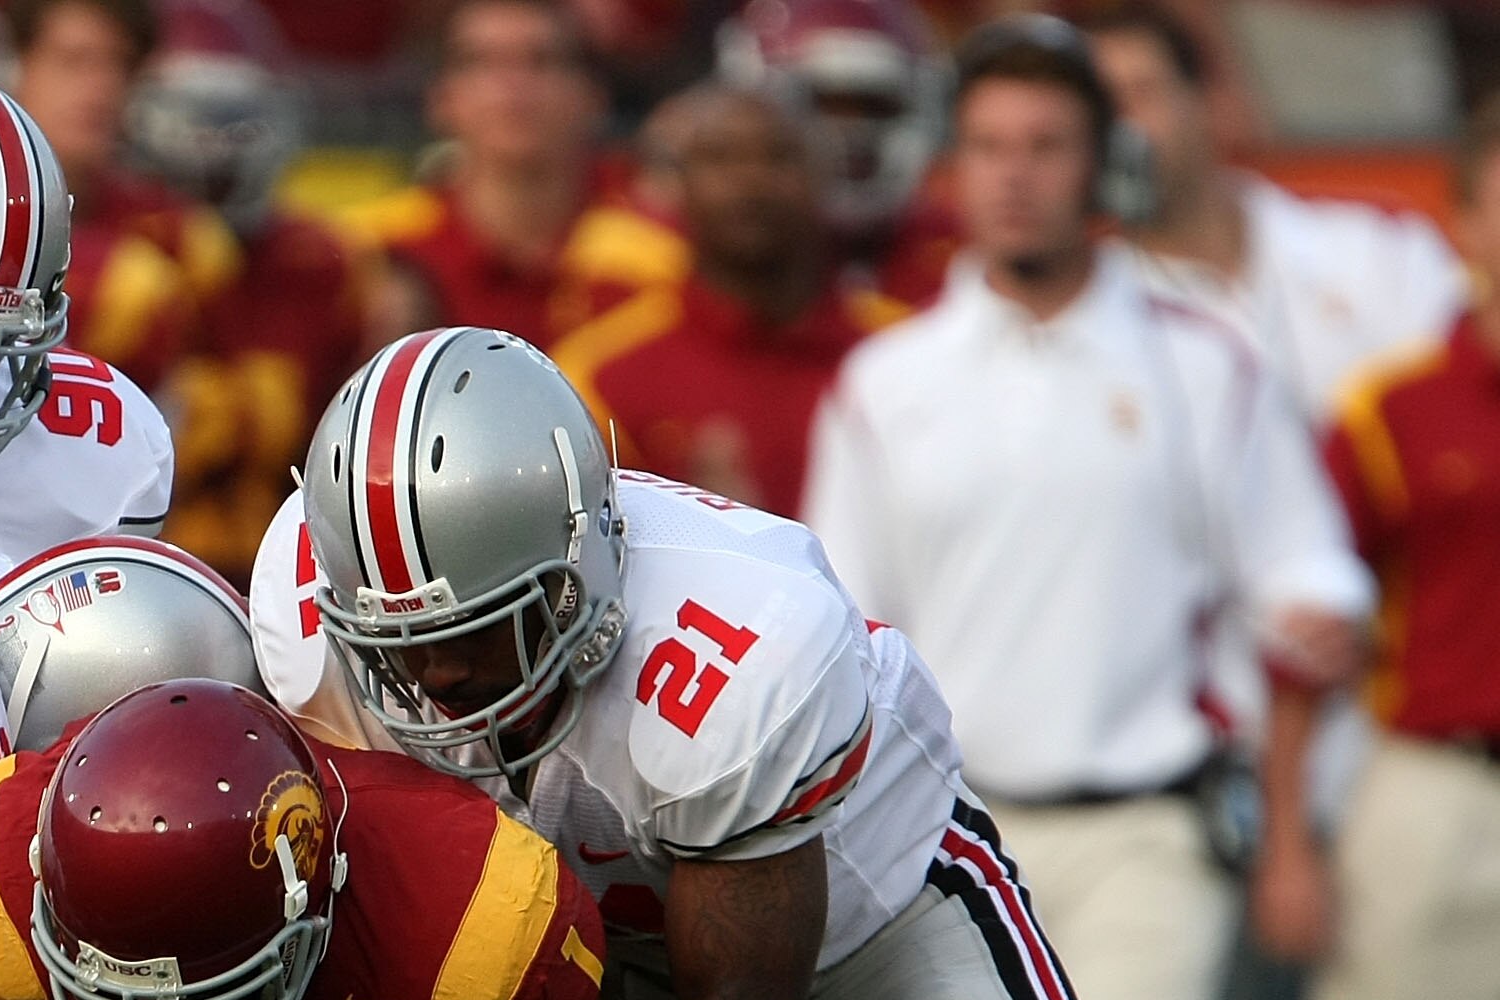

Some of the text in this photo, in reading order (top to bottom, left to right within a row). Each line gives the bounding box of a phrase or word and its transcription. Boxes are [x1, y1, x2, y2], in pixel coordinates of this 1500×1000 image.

[38, 346, 122, 447] 90
[636, 598, 760, 738] 21
[103, 959, 151, 976] USC
